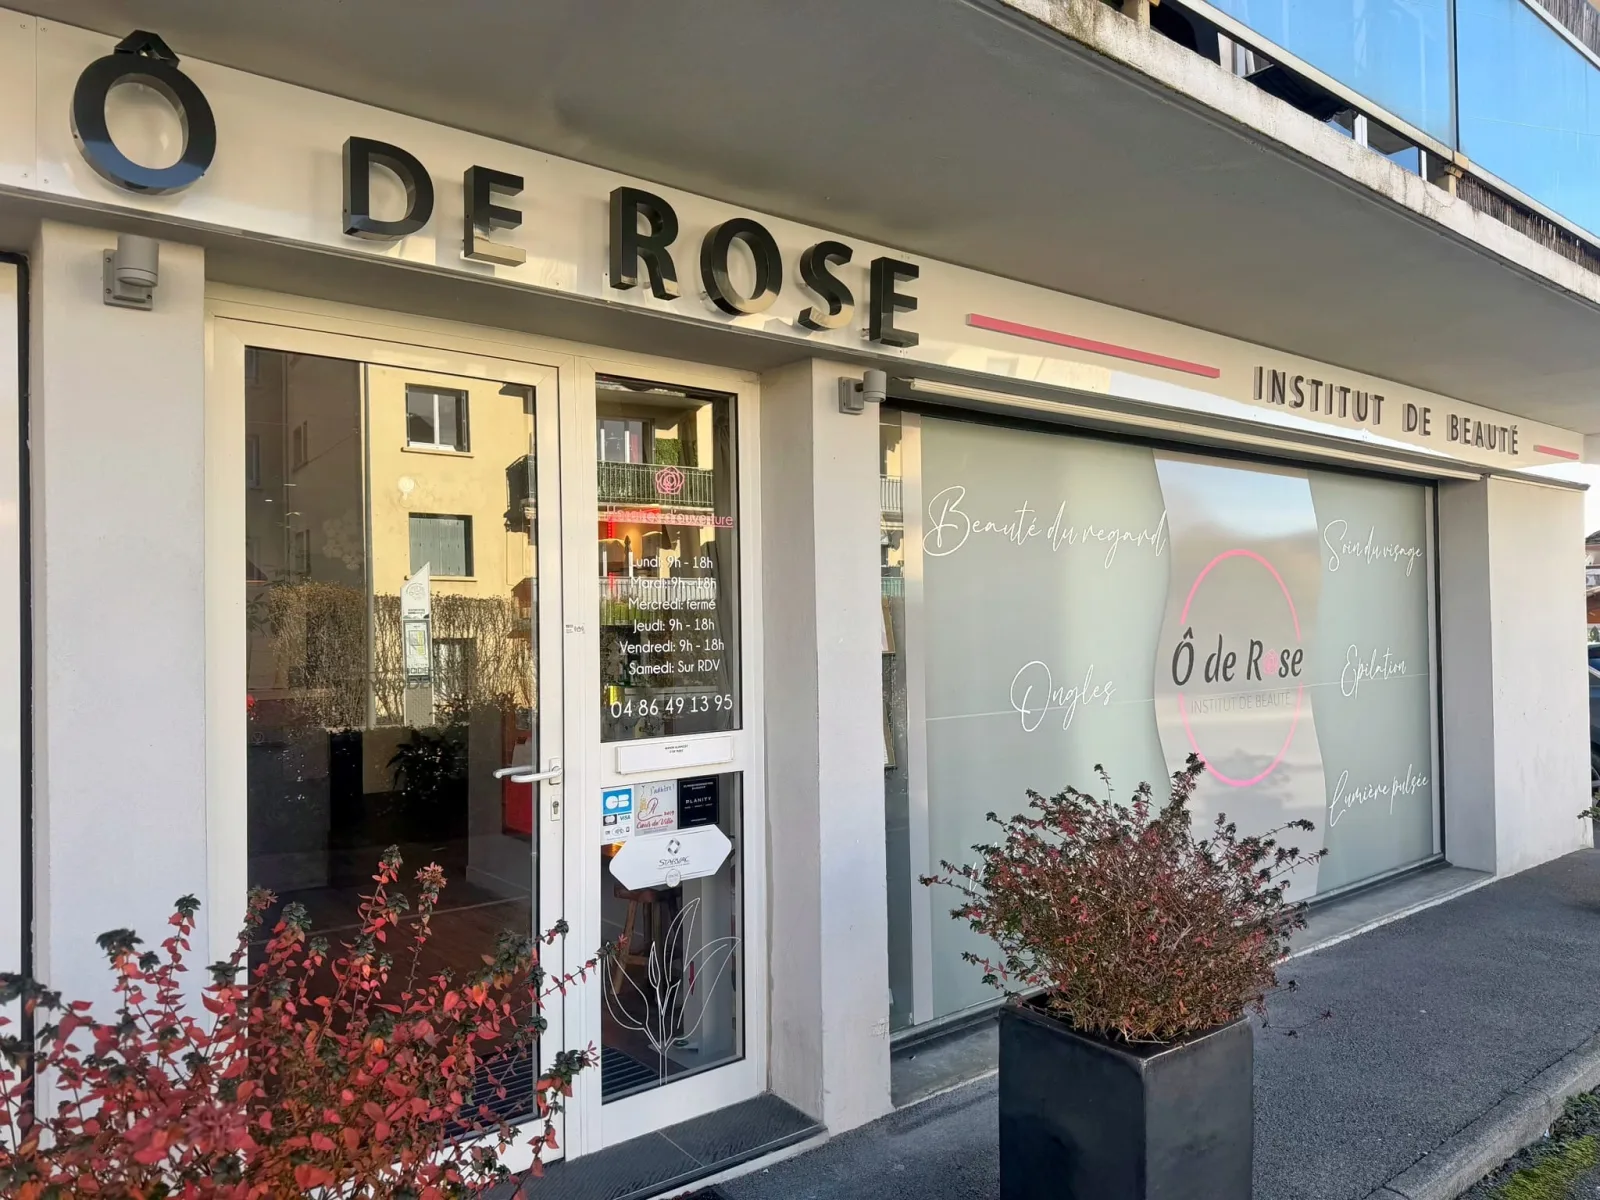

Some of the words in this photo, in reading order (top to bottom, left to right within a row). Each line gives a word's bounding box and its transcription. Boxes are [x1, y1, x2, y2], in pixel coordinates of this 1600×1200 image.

[70, 29, 217, 195] Ô
[342, 136, 527, 267] DE
[609, 185, 920, 347] ROSE
[1253, 366, 1385, 426] INSTITUT
[1402, 403, 1431, 436] DE
[1447, 412, 1519, 456] BEAUTÉ
[923, 485, 1042, 557] Beauté
[1046, 500, 1078, 551] du
[1081, 509, 1168, 569] regard
[666, 556, 682, 569] 9h
[693, 557, 713, 569] 18h
[670, 577, 687, 590] 9h
[628, 598, 684, 611] Mercredi:
[686, 598, 716, 611] fermé
[633, 618, 666, 634] Jeudi:
[669, 618, 683, 631] 9h
[694, 617, 715, 631] 18h
[619, 640, 677, 654] Vendredi:
[679, 640, 694, 653] 9h
[704, 638, 725, 652] 18h
[1172, 626, 1194, 687] Ô
[1204, 633, 1236, 683] de
[1246, 638, 1304, 681] Rose
[628, 660, 675, 676] Samedi:
[677, 659, 695, 674] Sur
[697, 658, 721, 672] RDV
[610, 701, 633, 719] 04
[638, 698, 659, 716] 86
[665, 696, 685, 714] 49
[691, 695, 709, 712] 13
[715, 694, 733, 710] 95
[1009, 660, 1117, 733] Ongles
[1190, 697, 1237, 715] INSTITUT
[1238, 695, 1252, 709] DE
[1254, 691, 1292, 707] BEAUTÉ
[685, 796, 712, 804] PLANITY
